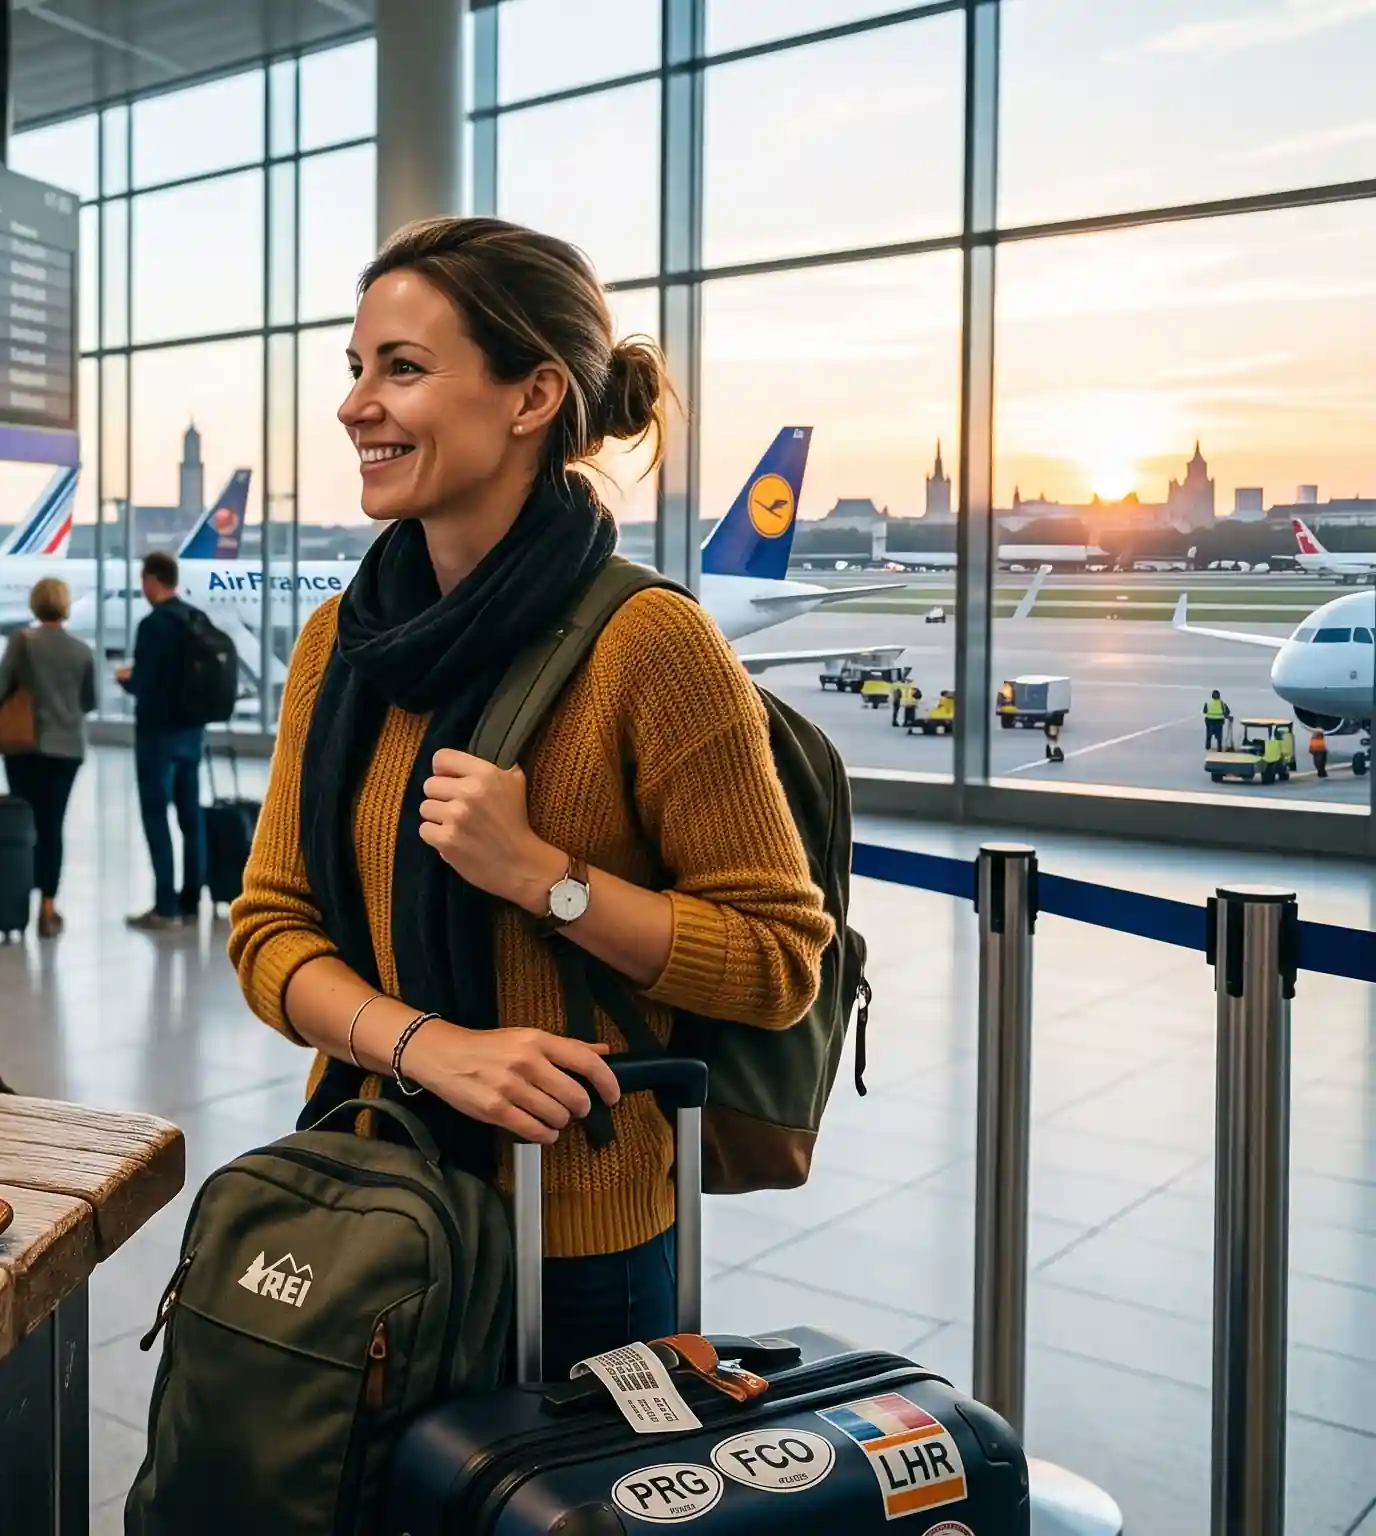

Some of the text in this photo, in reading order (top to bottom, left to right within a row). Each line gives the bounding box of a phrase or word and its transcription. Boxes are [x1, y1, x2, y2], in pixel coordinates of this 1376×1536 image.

[259, 1270, 312, 1308] REI
[729, 1438, 814, 1477] FCO
[879, 1442, 955, 1490] LHR
[624, 1470, 710, 1510] PRG
